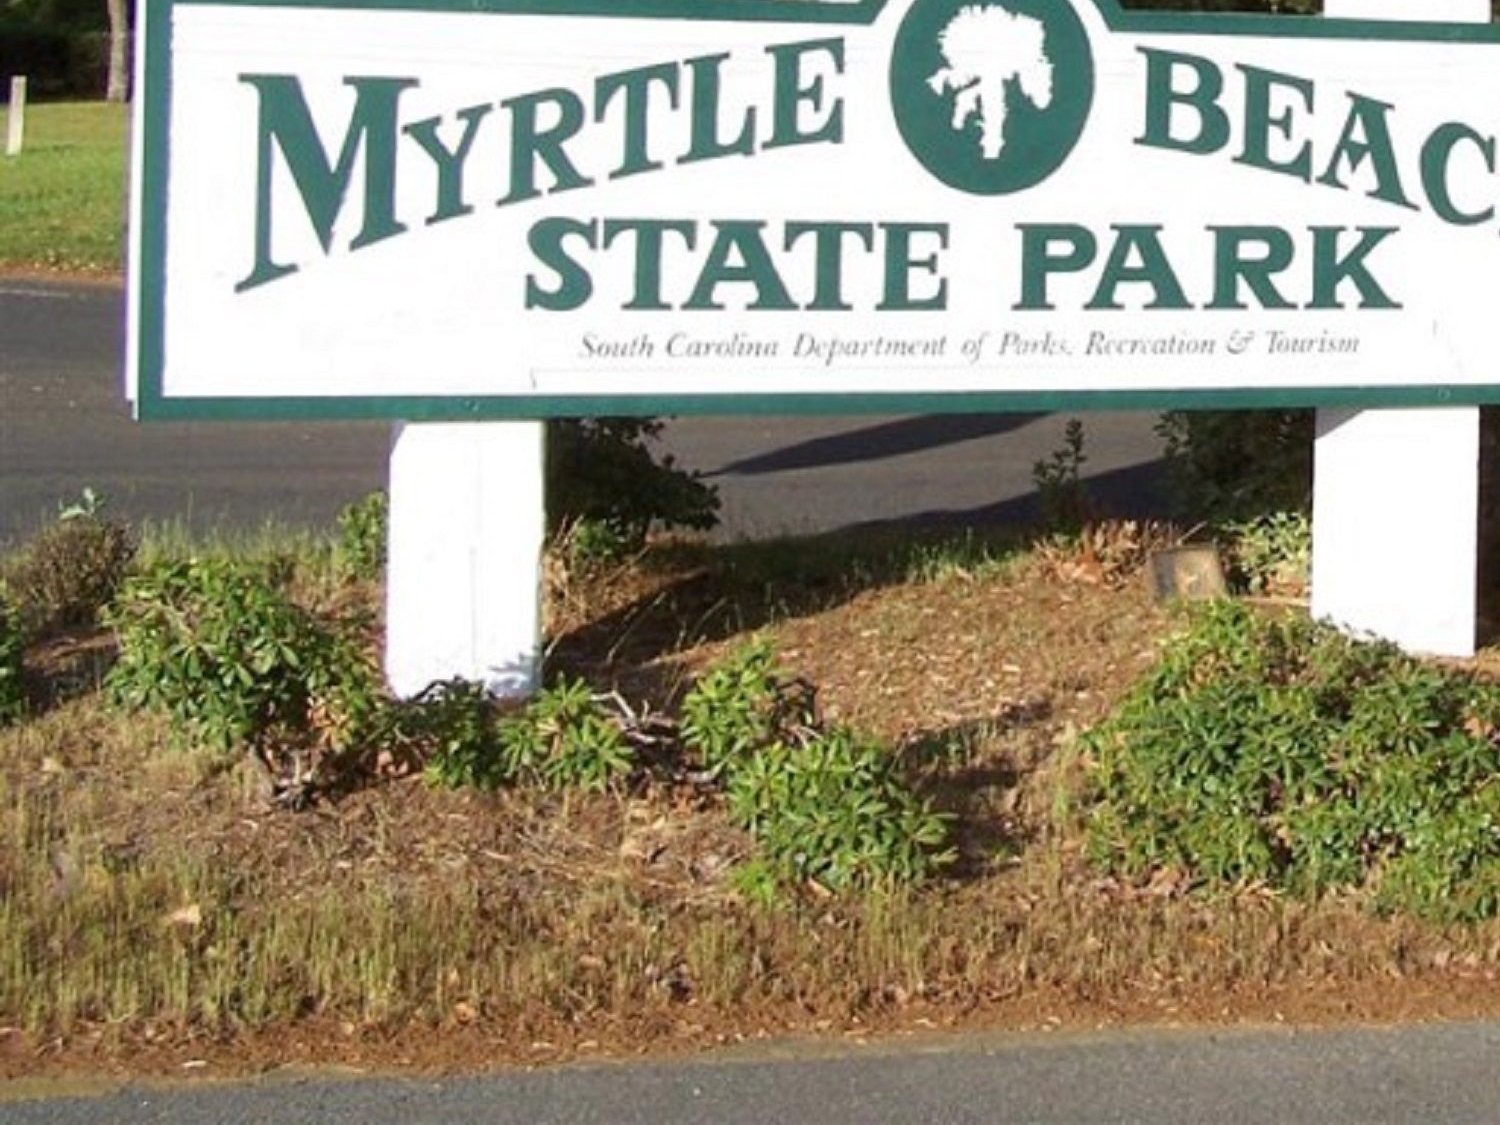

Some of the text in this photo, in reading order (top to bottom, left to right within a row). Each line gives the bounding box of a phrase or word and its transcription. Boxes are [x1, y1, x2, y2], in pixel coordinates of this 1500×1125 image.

[236, 37, 845, 292] MYRTLE
[525, 220, 1403, 311] STATE PARK
[581, 333, 655, 359] South
[665, 331, 779, 358] Carolina
[793, 332, 947, 366] Department
[961, 331, 988, 364] of
[1085, 330, 1216, 356] Recreation
[1226, 330, 1256, 355] &
[1265, 329, 1360, 355] Tourism
